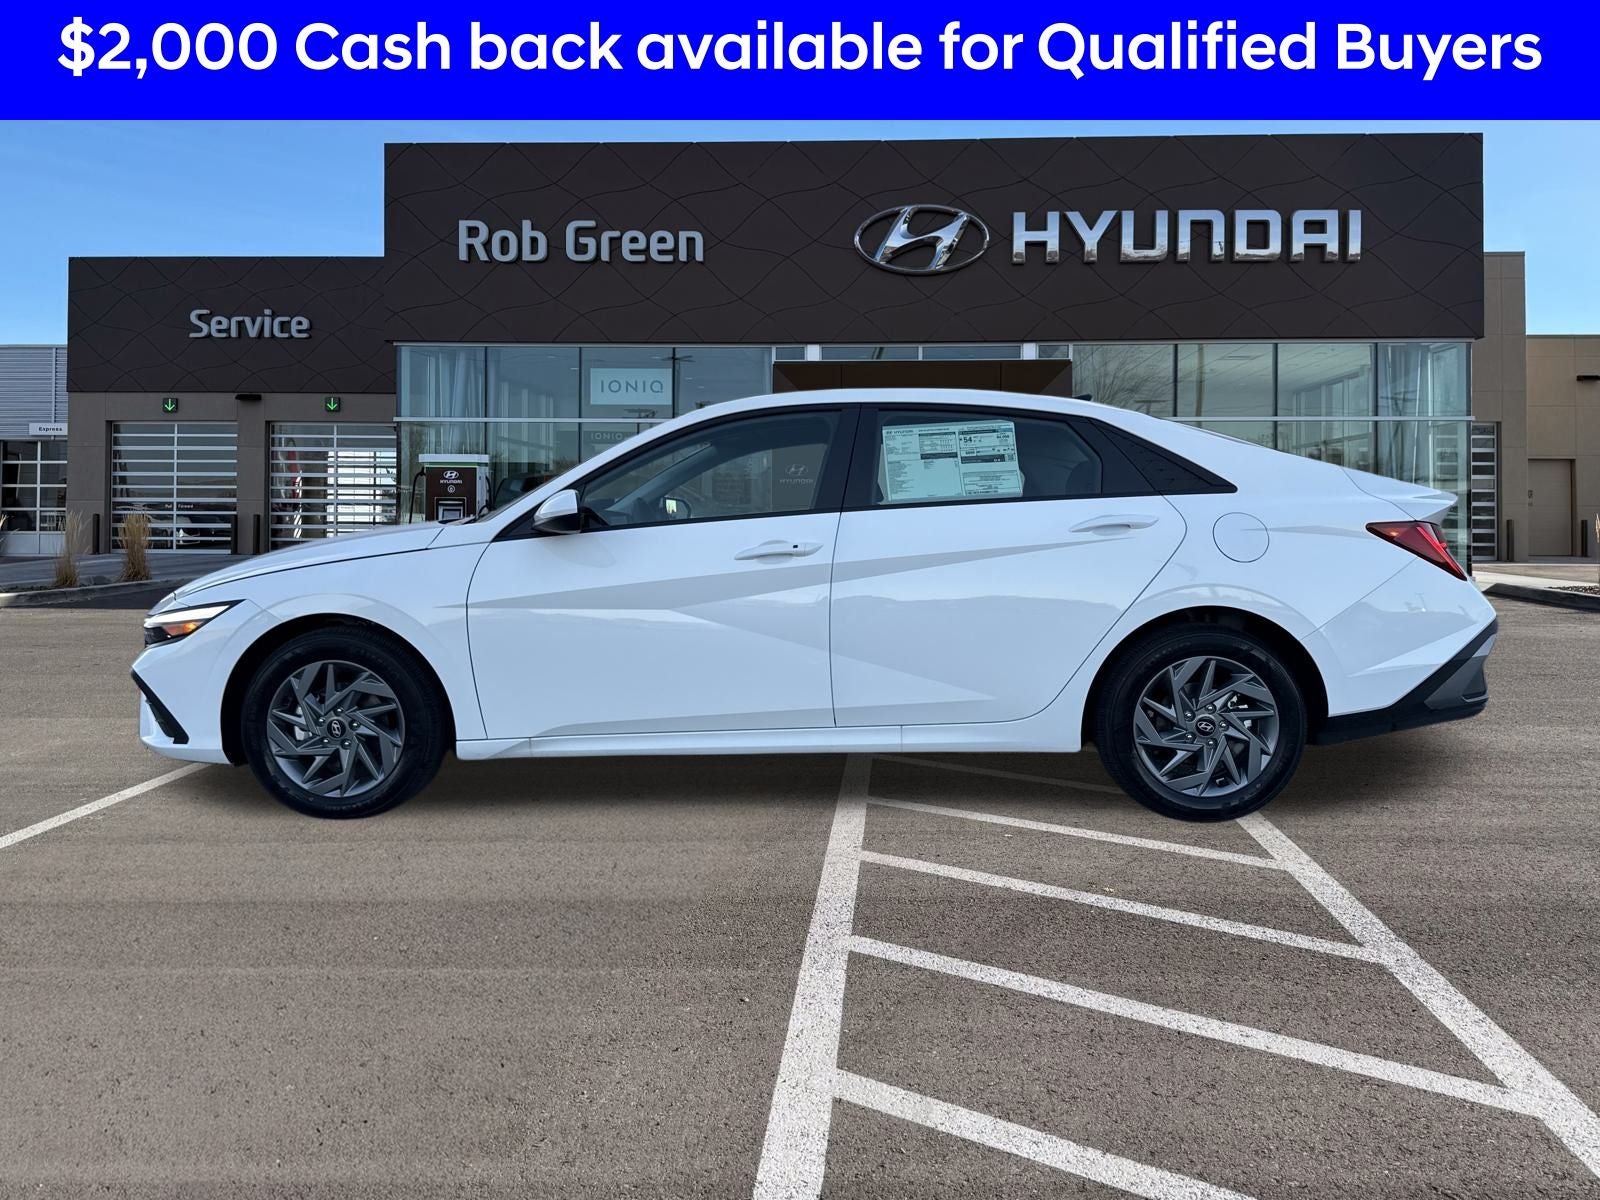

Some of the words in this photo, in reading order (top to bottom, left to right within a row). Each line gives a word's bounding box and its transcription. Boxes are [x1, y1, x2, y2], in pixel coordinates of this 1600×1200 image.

[458, 219, 548, 263] Rob
[565, 219, 705, 263] Green
[1011, 209, 1363, 264] HYUNDAI
[189, 308, 311, 339] Service
[601, 380, 664, 393] IONIQ
